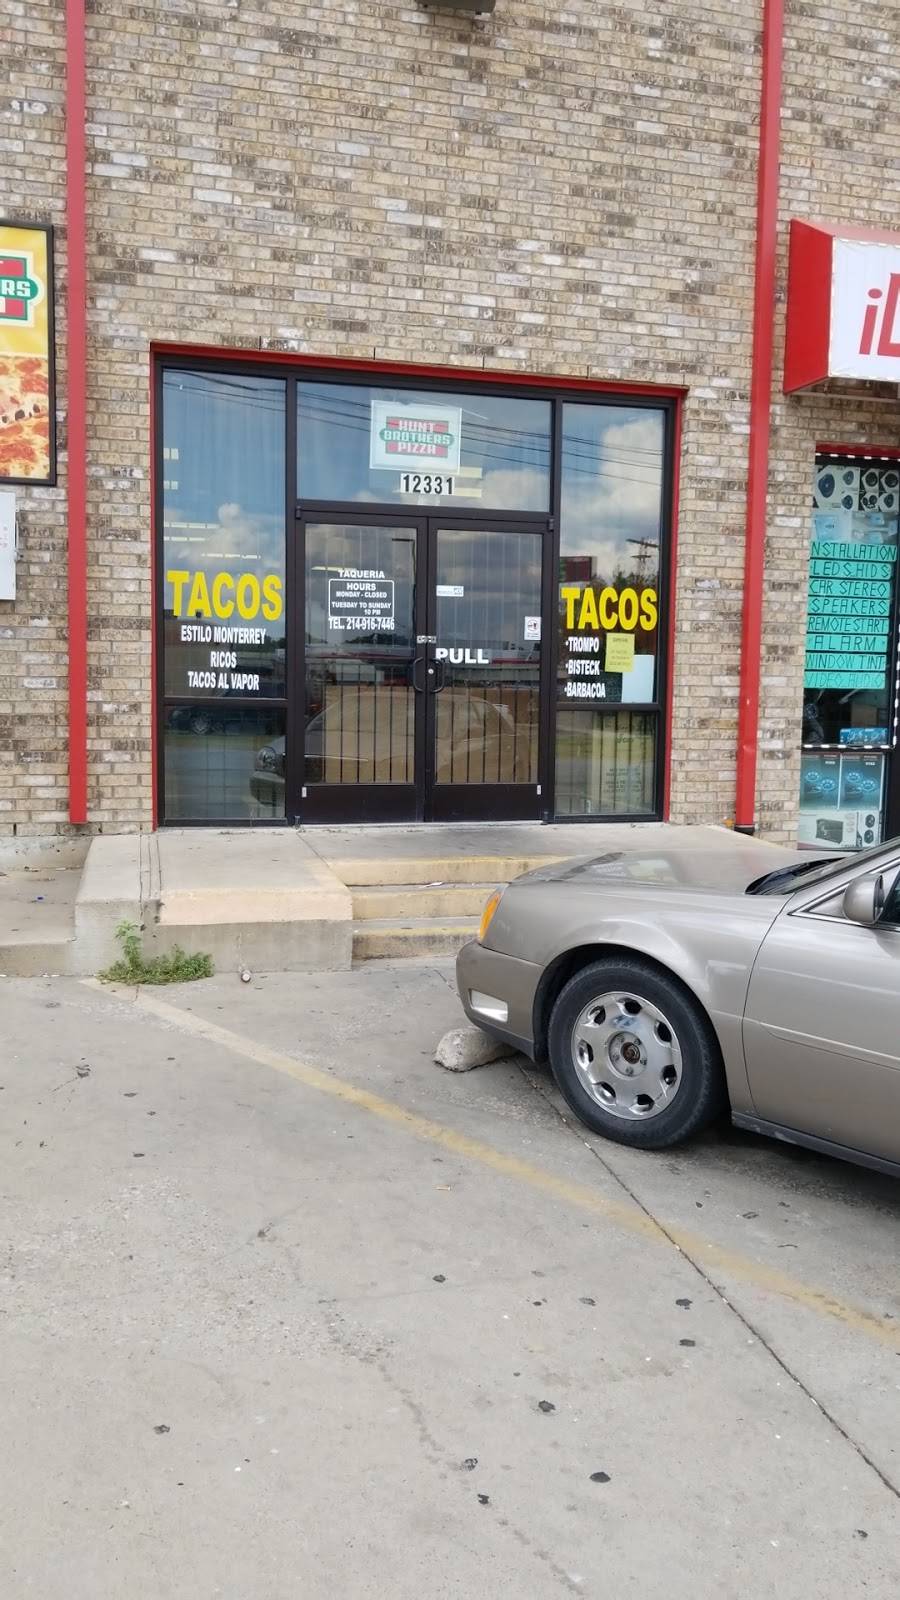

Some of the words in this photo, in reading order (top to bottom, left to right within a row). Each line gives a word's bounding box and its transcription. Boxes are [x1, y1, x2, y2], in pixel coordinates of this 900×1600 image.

[399, 420, 435, 433] HUNT
[383, 430, 450, 446] BROTHERS
[398, 442, 437, 455] PIZZA
[402, 474, 454, 495] 12331
[338, 569, 385, 579] TAQUERIA
[346, 582, 377, 591] HOURS
[810, 579, 833, 594] CAR
[840, 581, 887, 597] STEREO
[166, 570, 283, 621] TACOS
[364, 591, 388, 599] CLOSED
[331, 601, 358, 609] TUESDAY
[560, 586, 658, 631] TACOS
[811, 598, 887, 615] SPEAKERS
[328, 617, 345, 630] TEL.
[181, 625, 212, 643] ESTILO
[213, 626, 267, 645] MONTERREY
[814, 635, 877, 651] ALARM
[210, 651, 238, 669] RICOS
[435, 647, 490, 665] PULL
[806, 654, 855, 669] WINDOW
[860, 655, 886, 669] TINT
[187, 671, 217, 689] TACOS
[217, 672, 230, 689] AL
[230, 673, 260, 690] VAPOR
